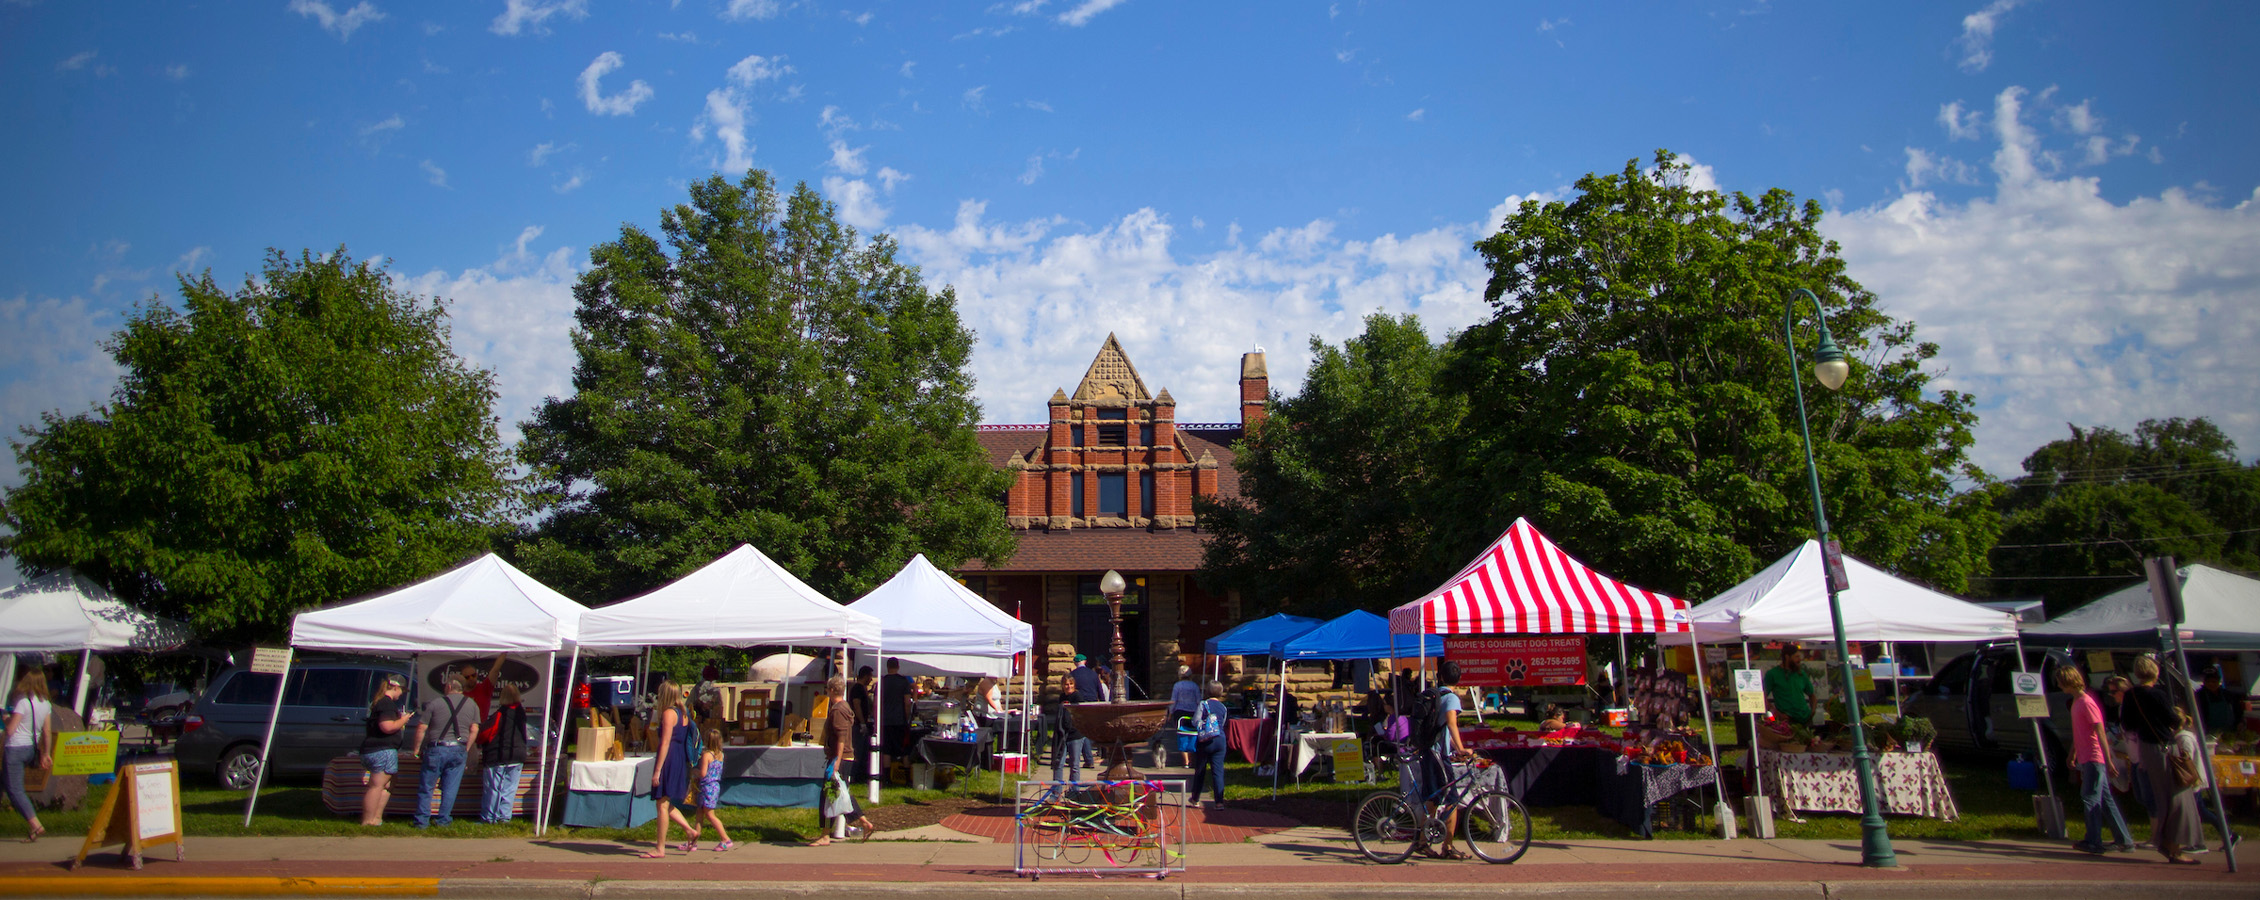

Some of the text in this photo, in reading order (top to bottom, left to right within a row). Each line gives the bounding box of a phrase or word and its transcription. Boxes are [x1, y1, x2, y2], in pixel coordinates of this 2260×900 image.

[1487, 640, 1527, 648] GOURMET
[1550, 638, 1581, 646] TREATS
[1531, 656, 1580, 665] 262-758-2695
